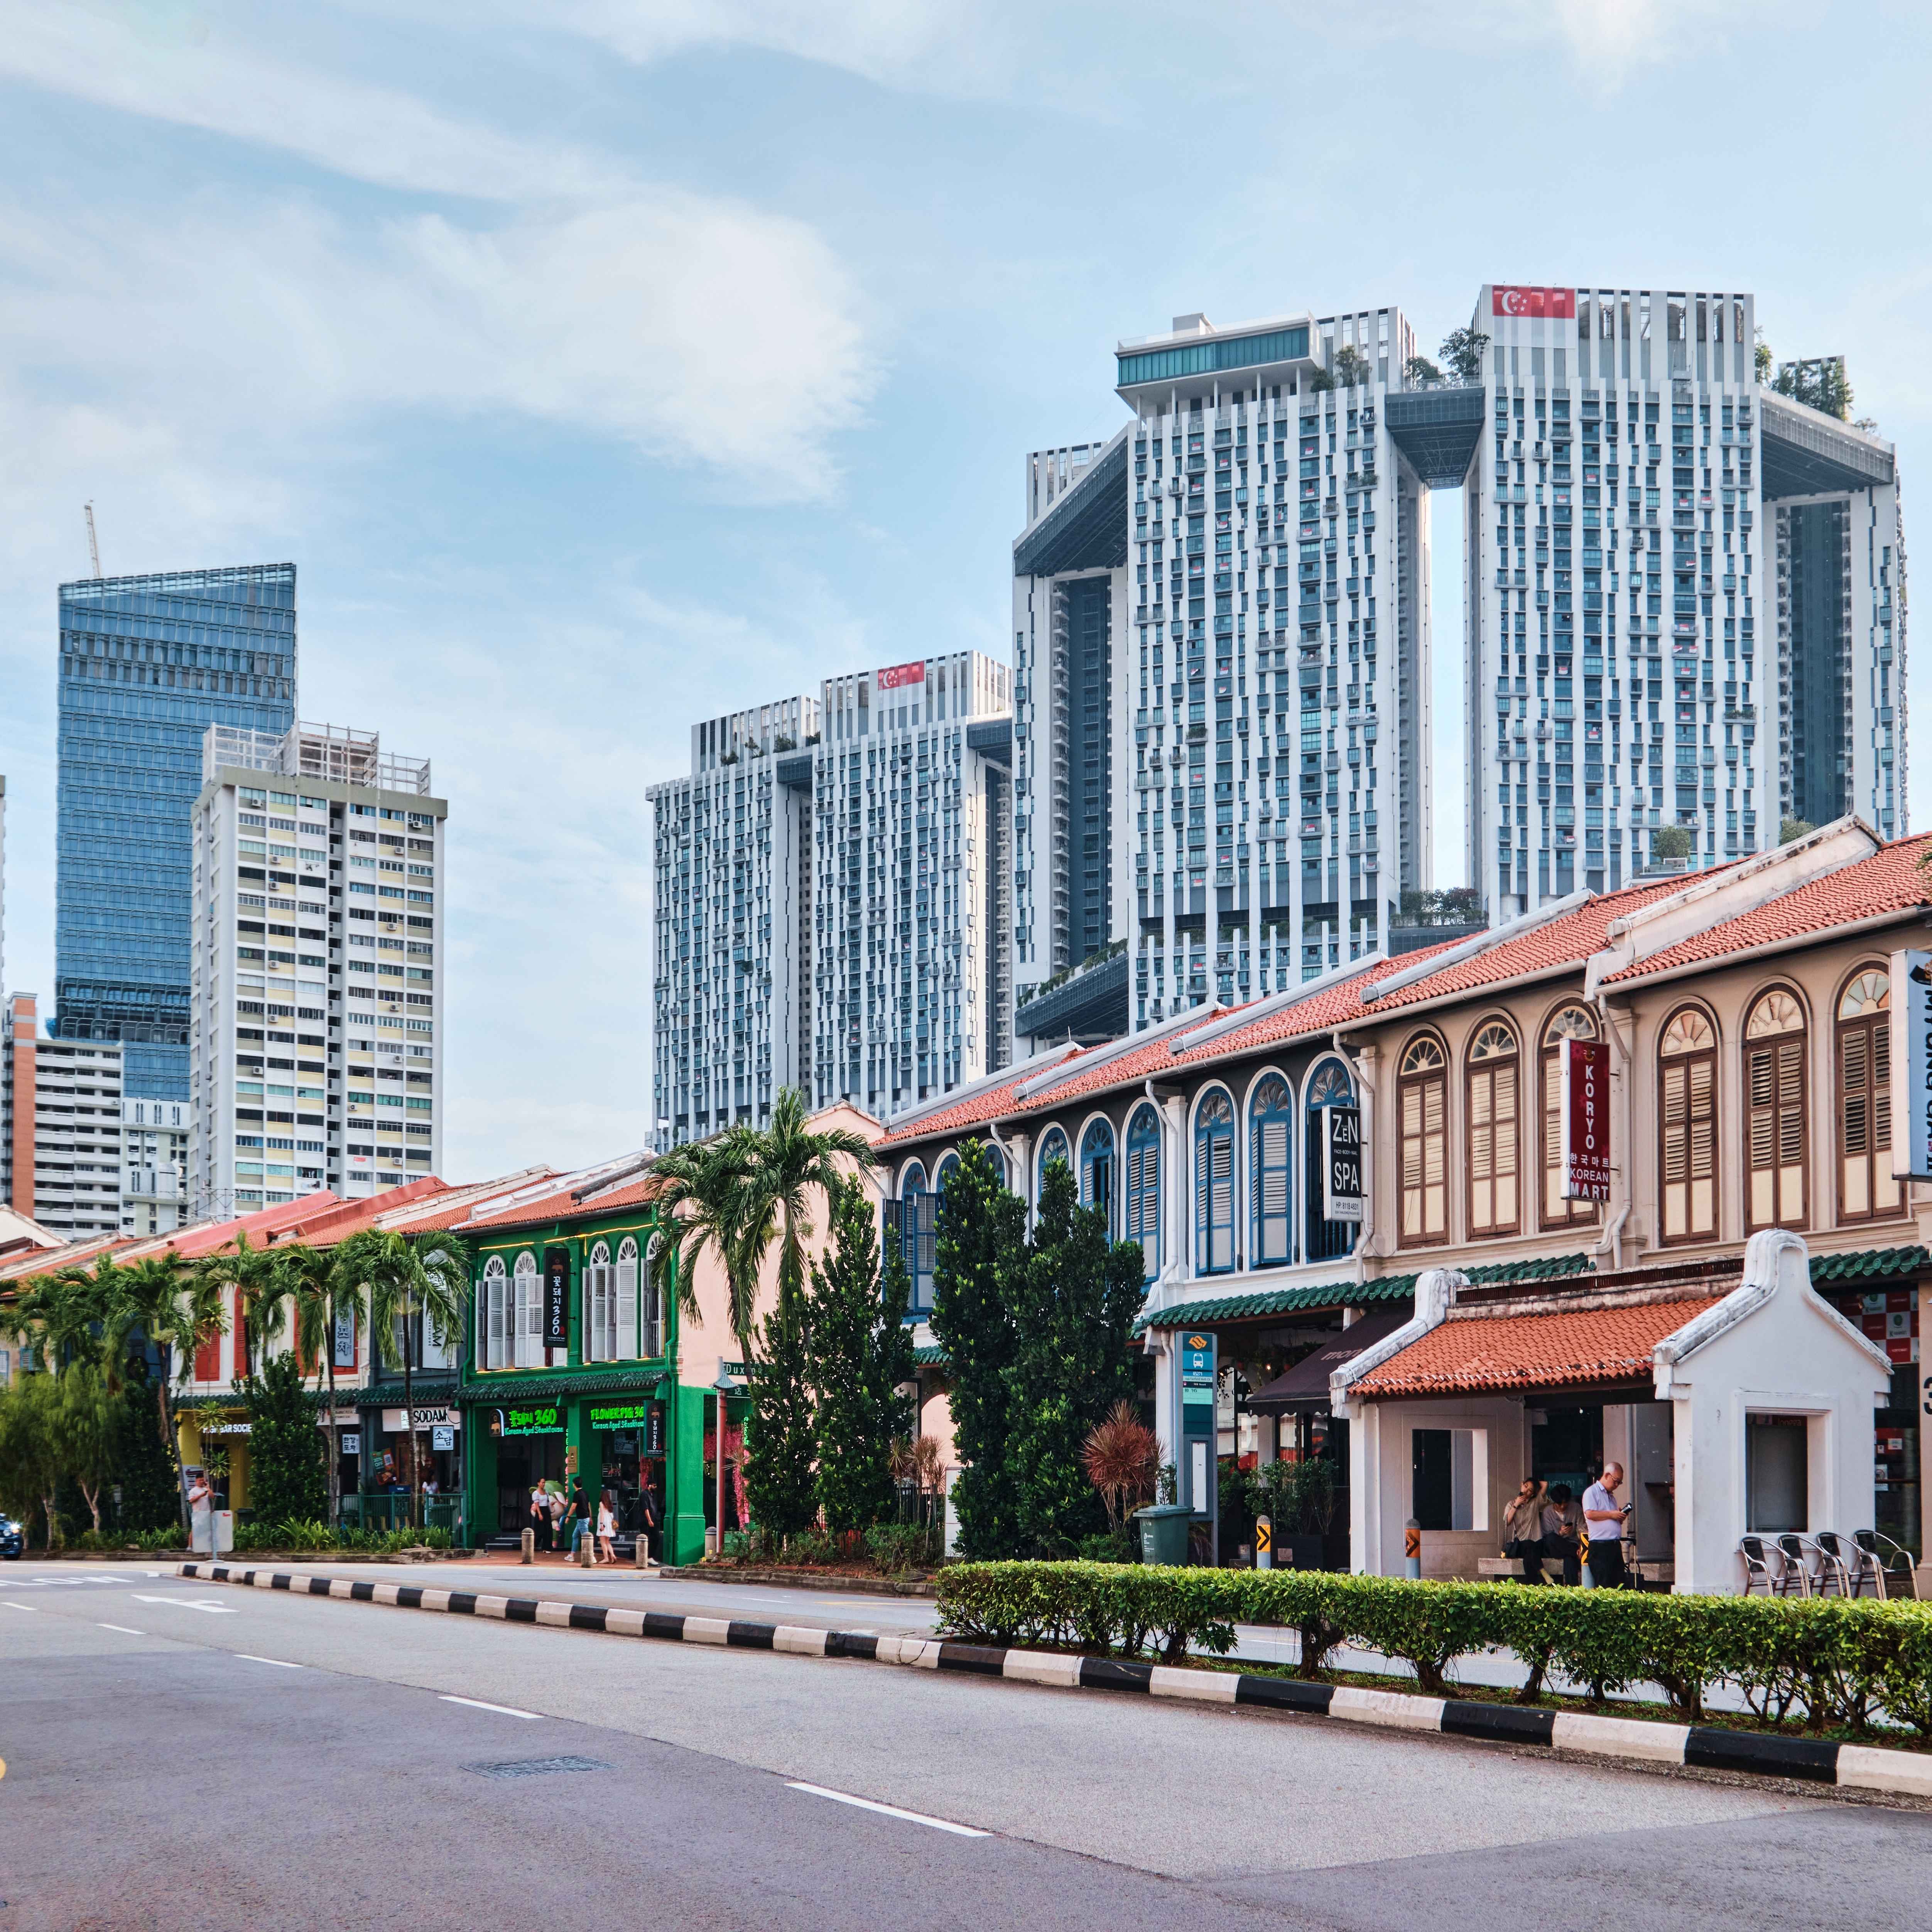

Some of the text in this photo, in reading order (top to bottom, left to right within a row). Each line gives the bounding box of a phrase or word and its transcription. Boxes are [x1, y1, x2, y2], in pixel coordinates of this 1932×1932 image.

[1585, 1065, 1594, 1150] KORYO
[1332, 1114, 1358, 1143] ZEN
[1570, 1153, 1609, 1167] 한국마트
[1334, 1162, 1359, 1191] SPA
[1570, 1168, 1608, 1182] KOREAN
[1571, 1181, 1608, 1200] MART
[726, 1364, 762, 1375] Duxo
[414, 1409, 446, 1423] SODAM
[534, 1408, 557, 1425] 360
[505, 1427, 522, 1435] Korean
[609, 1421, 621, 1431] Aged
[0, 1576, 135, 1586] LOW
